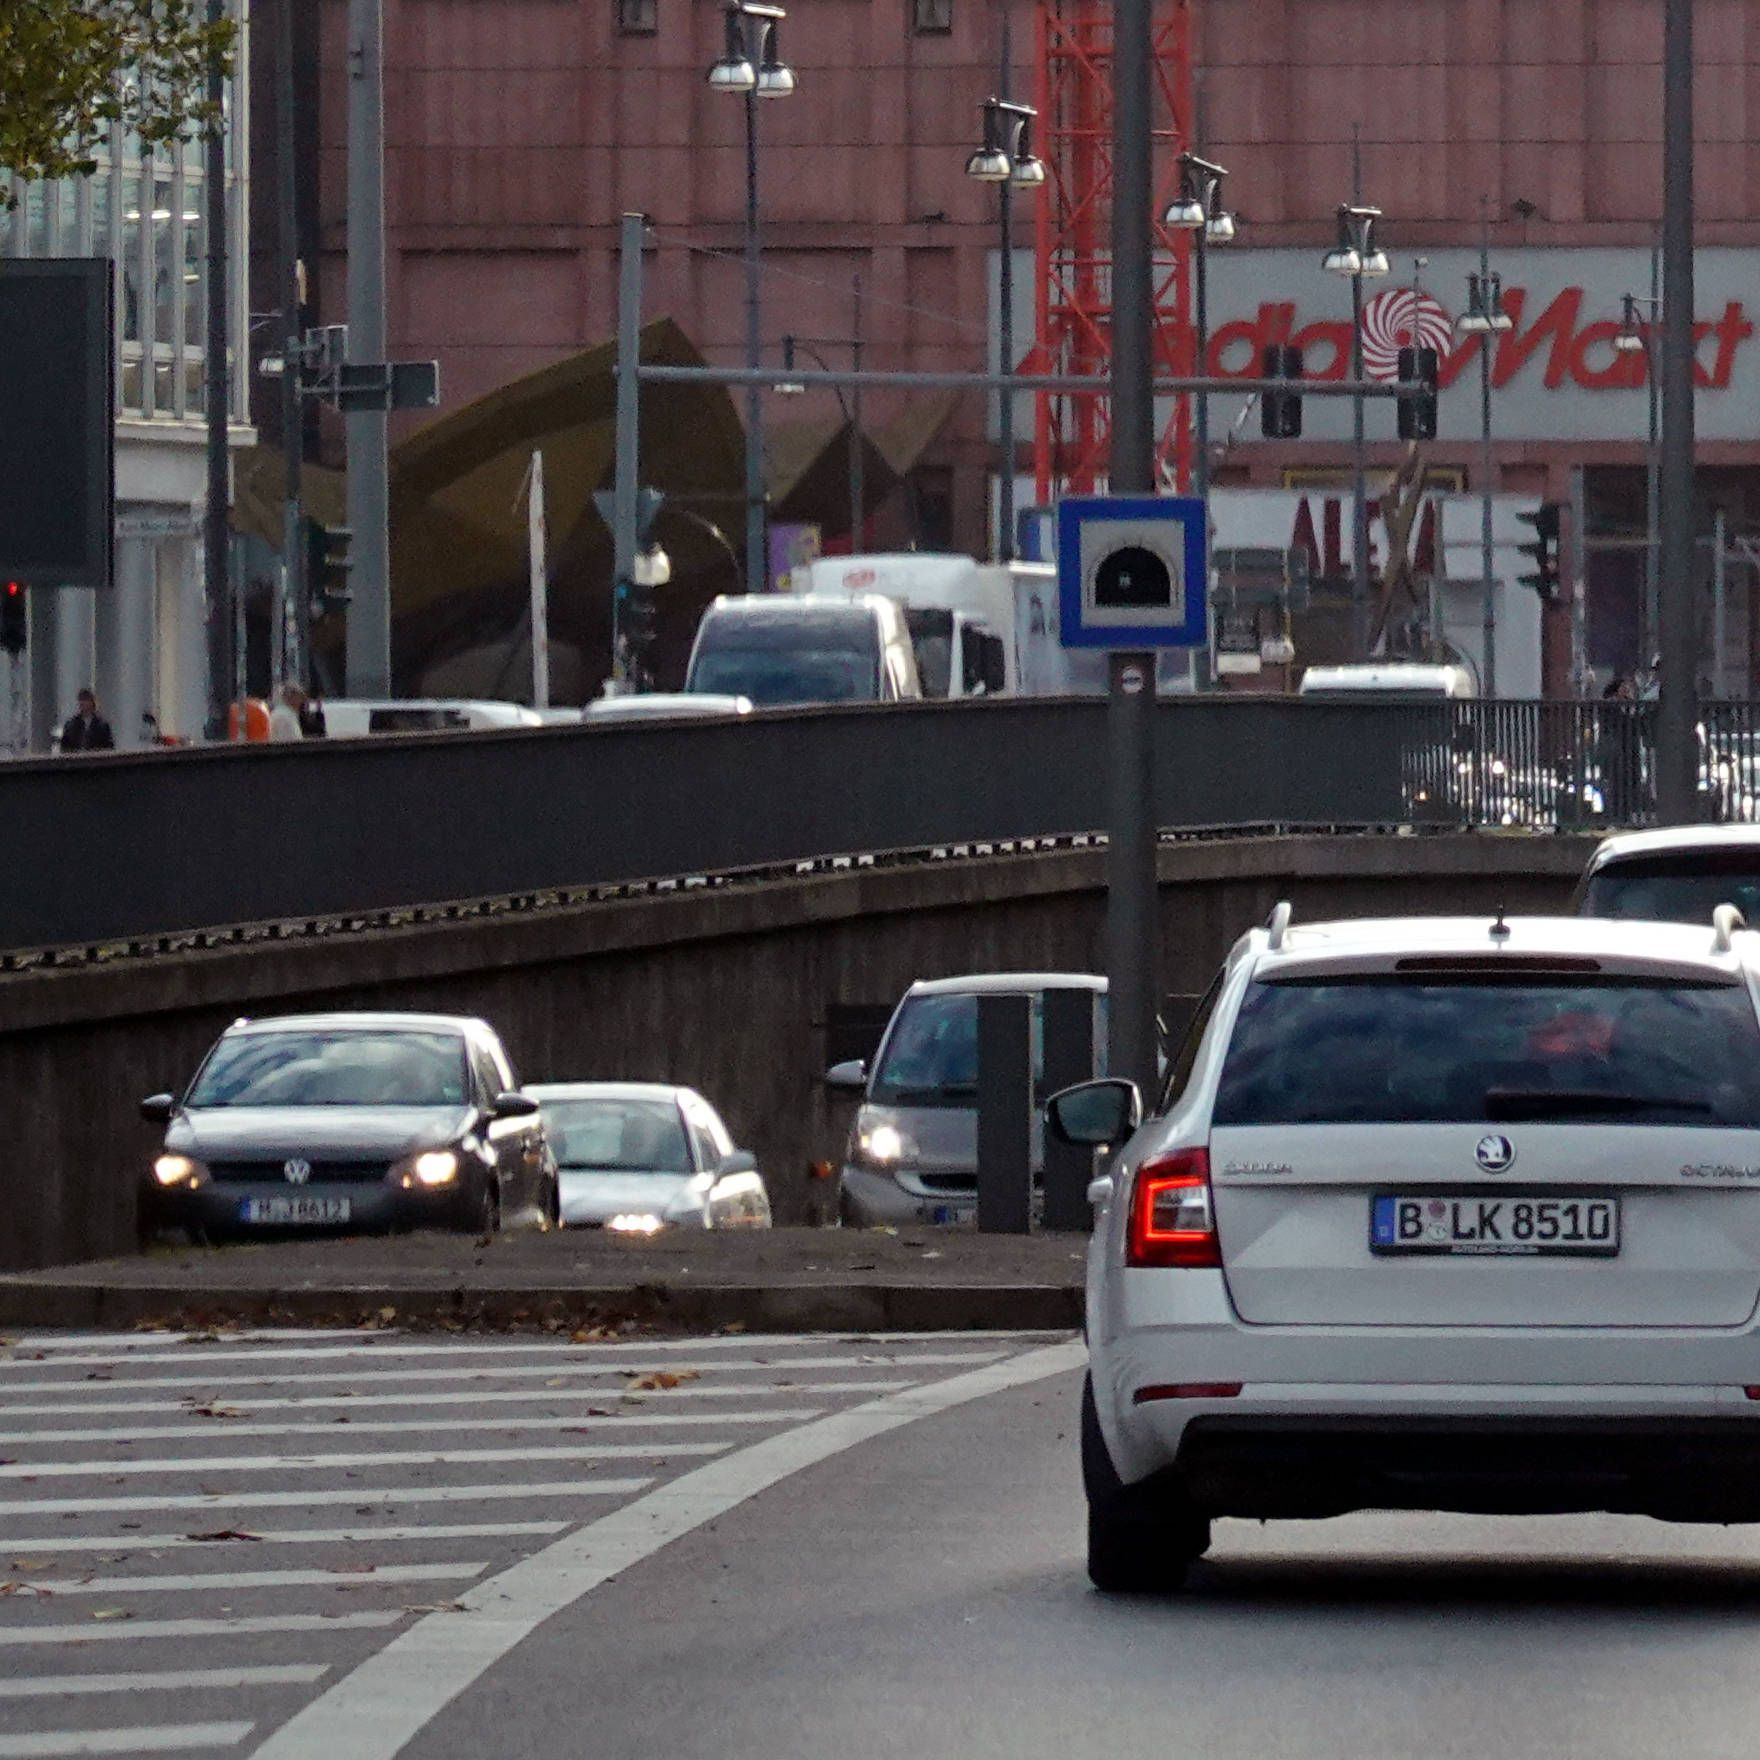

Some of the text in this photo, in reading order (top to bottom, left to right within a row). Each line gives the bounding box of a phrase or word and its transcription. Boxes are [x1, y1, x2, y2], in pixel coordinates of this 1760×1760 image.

[1400, 1202, 1610, 1241] B LK 8510
